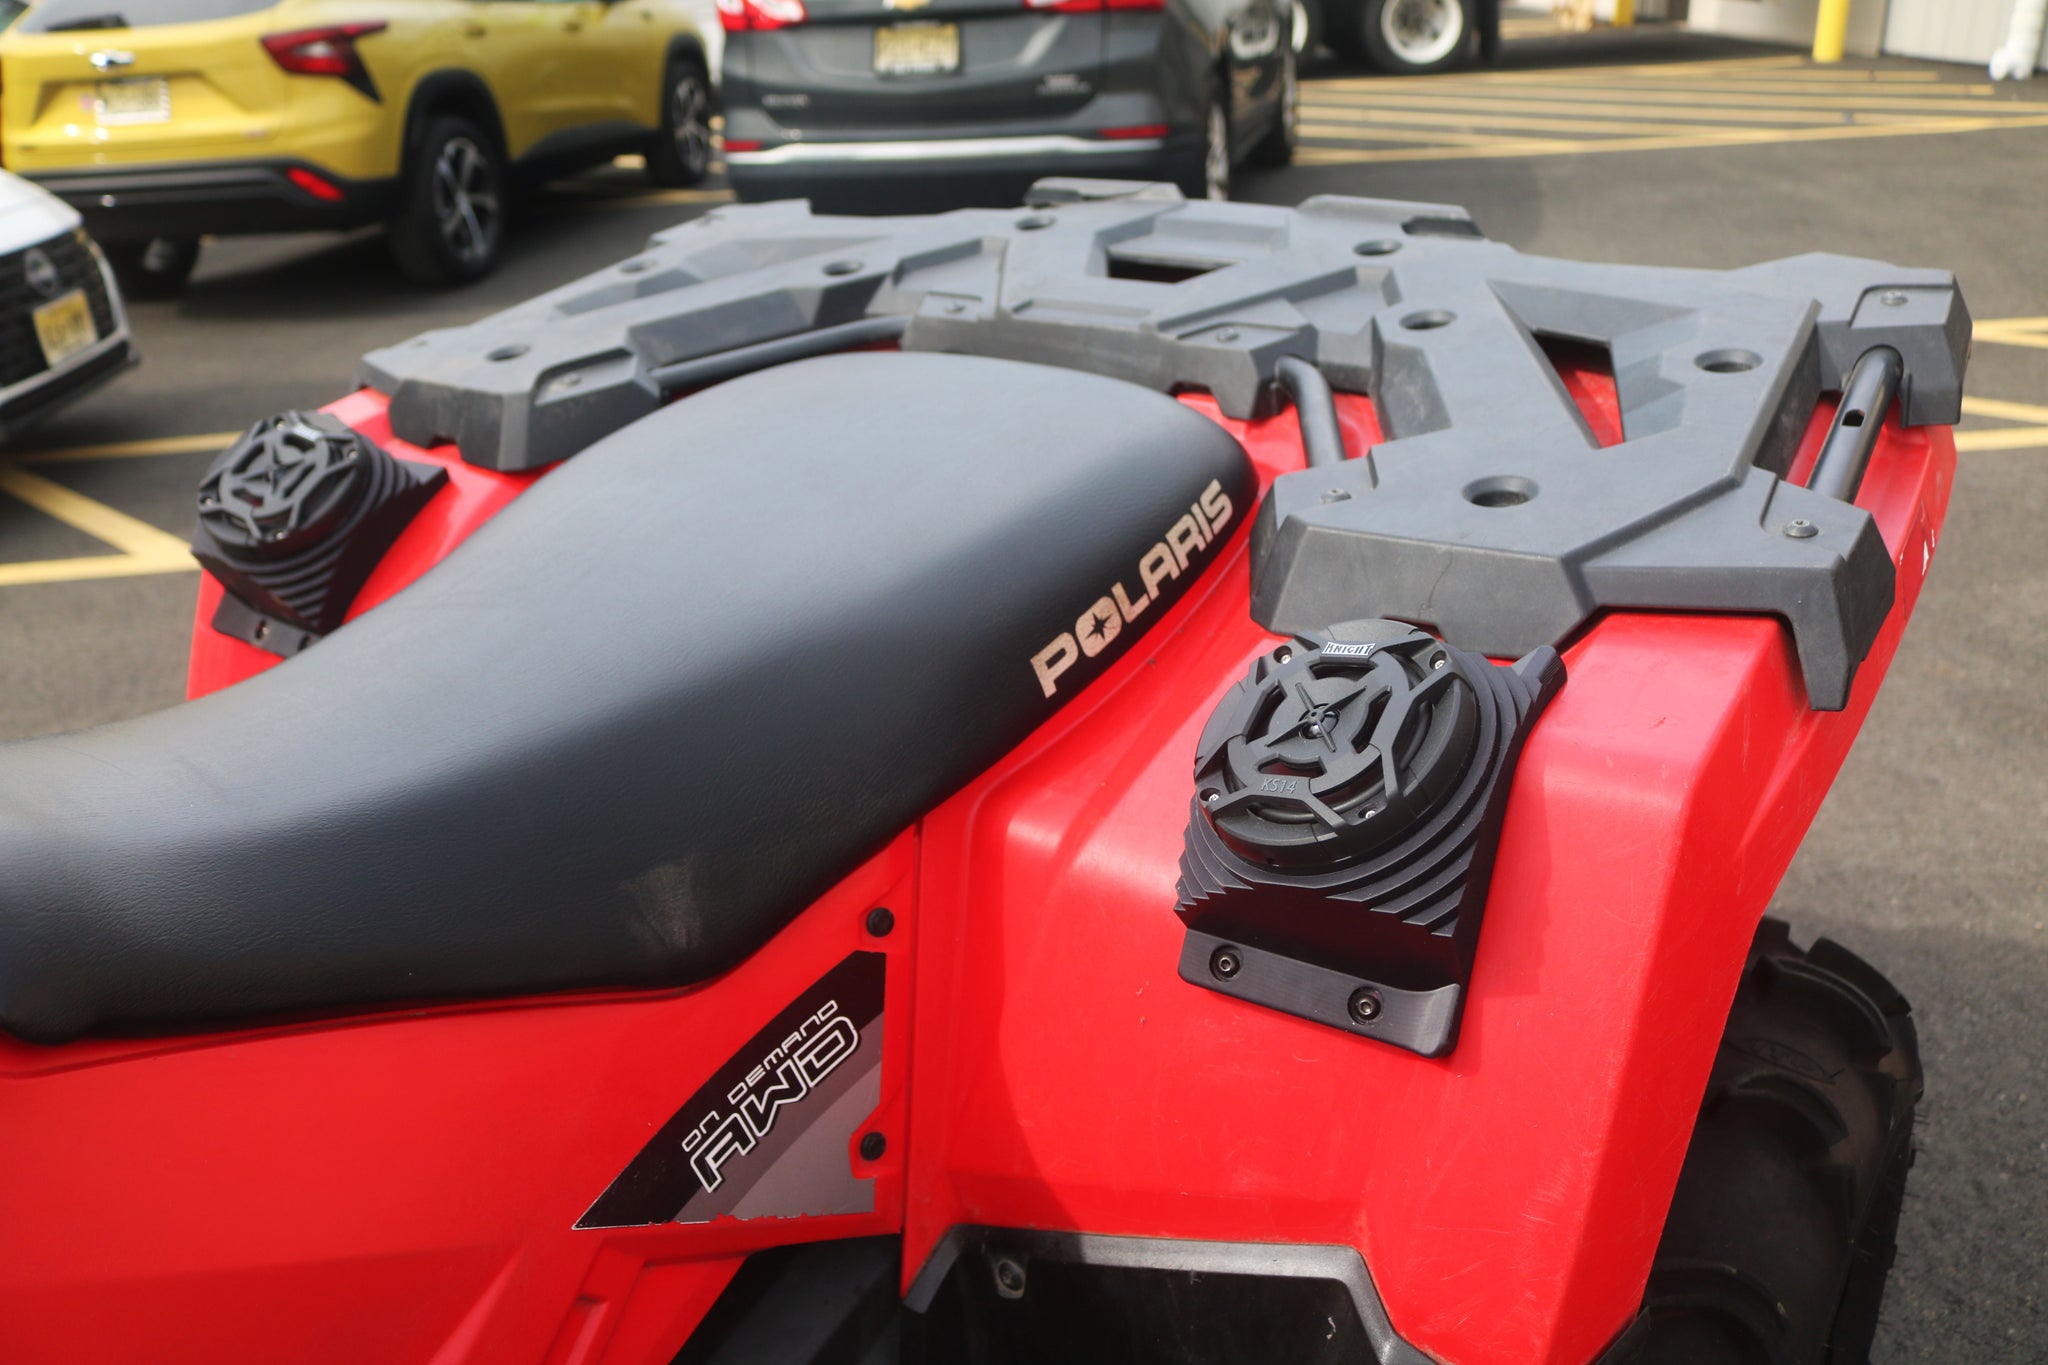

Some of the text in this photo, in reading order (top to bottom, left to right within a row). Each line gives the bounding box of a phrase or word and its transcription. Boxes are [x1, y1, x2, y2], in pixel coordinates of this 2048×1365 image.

[1030, 478, 1234, 698] POLARIS
[1323, 642, 1375, 655] KNIGHT
[1260, 777, 1298, 794] KS14
[682, 1000, 839, 1153] ON DEMAND
[690, 1016, 859, 1193] AWD
